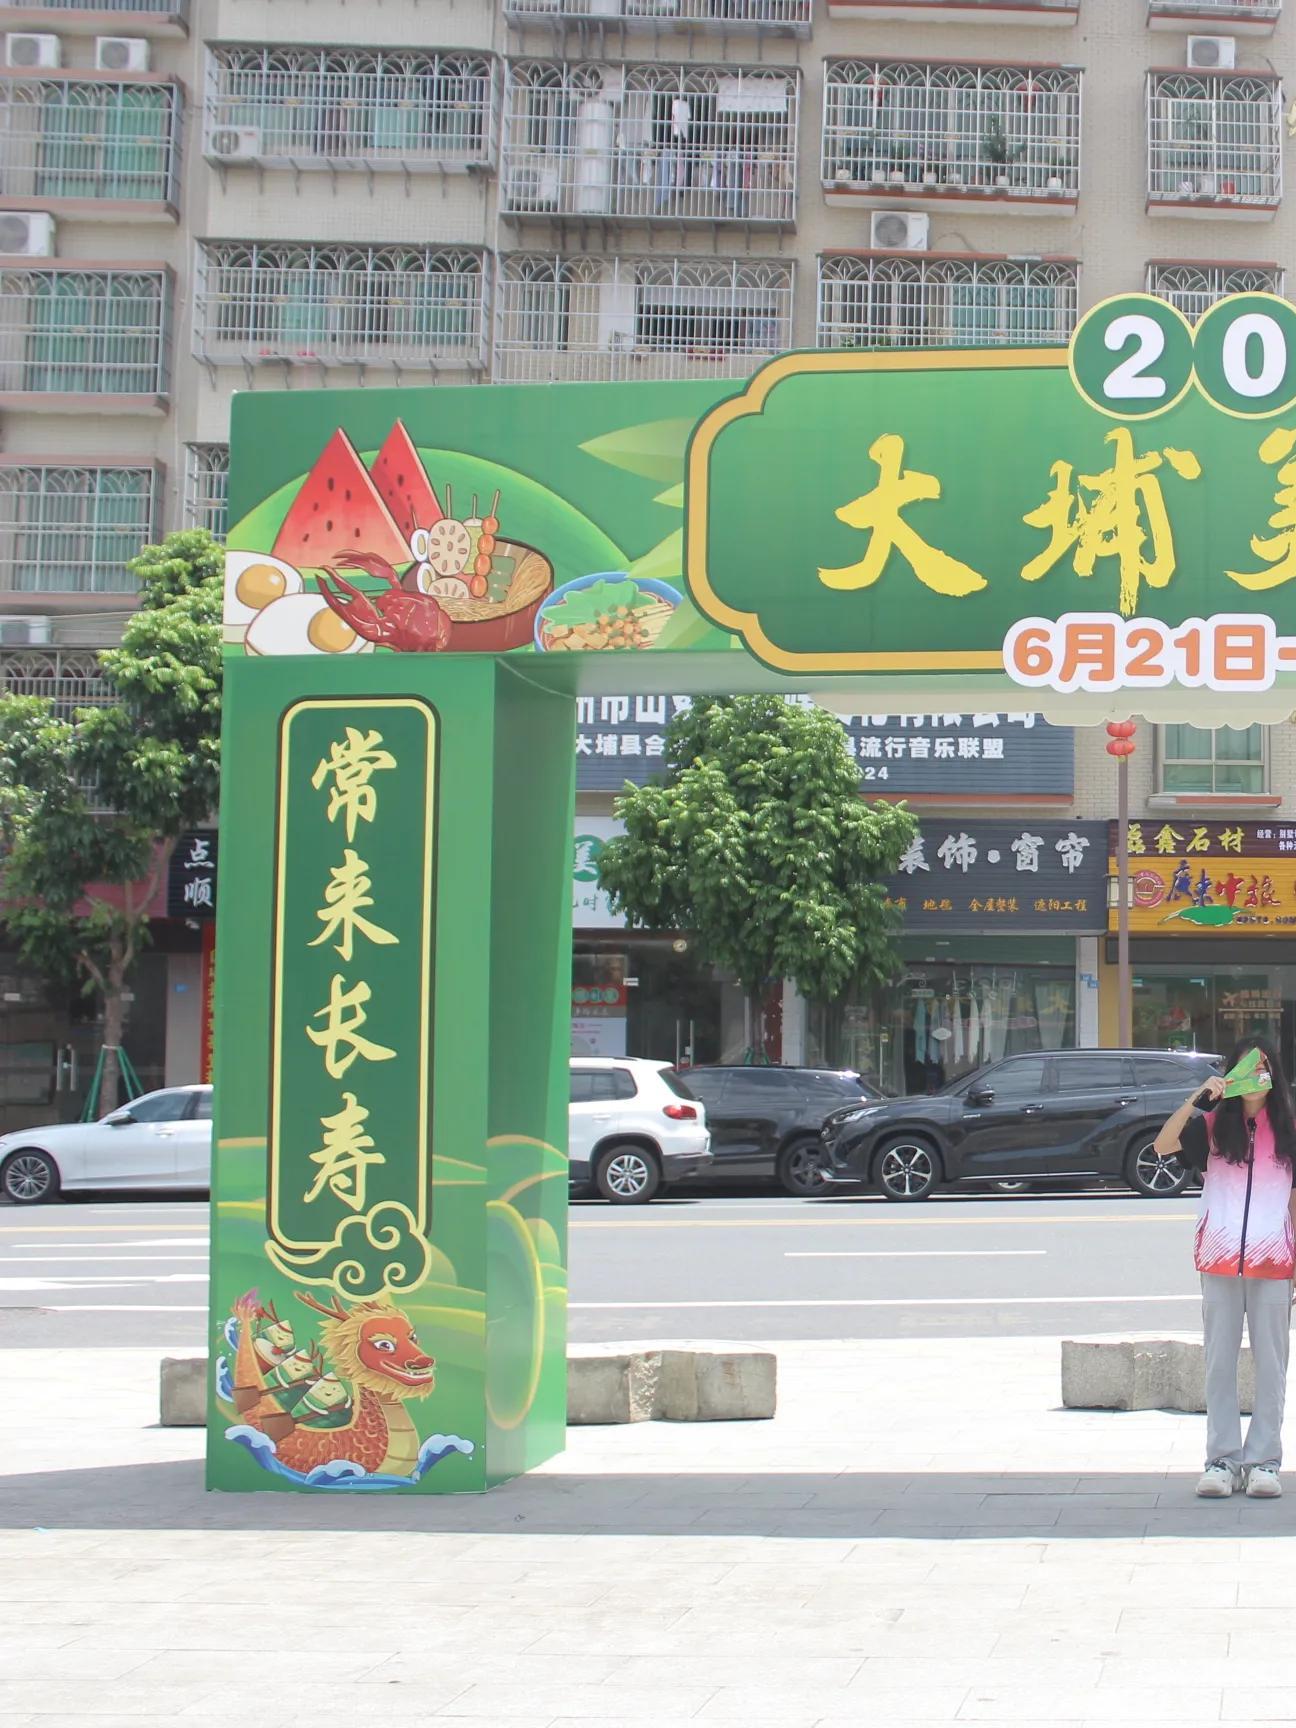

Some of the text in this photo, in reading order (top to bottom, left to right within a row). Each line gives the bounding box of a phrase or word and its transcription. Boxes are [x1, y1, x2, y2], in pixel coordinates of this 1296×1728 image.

[183, 838, 215, 868] 点
[183, 877, 213, 908] 顺
[304, 726, 400, 1212] 常来长寿
